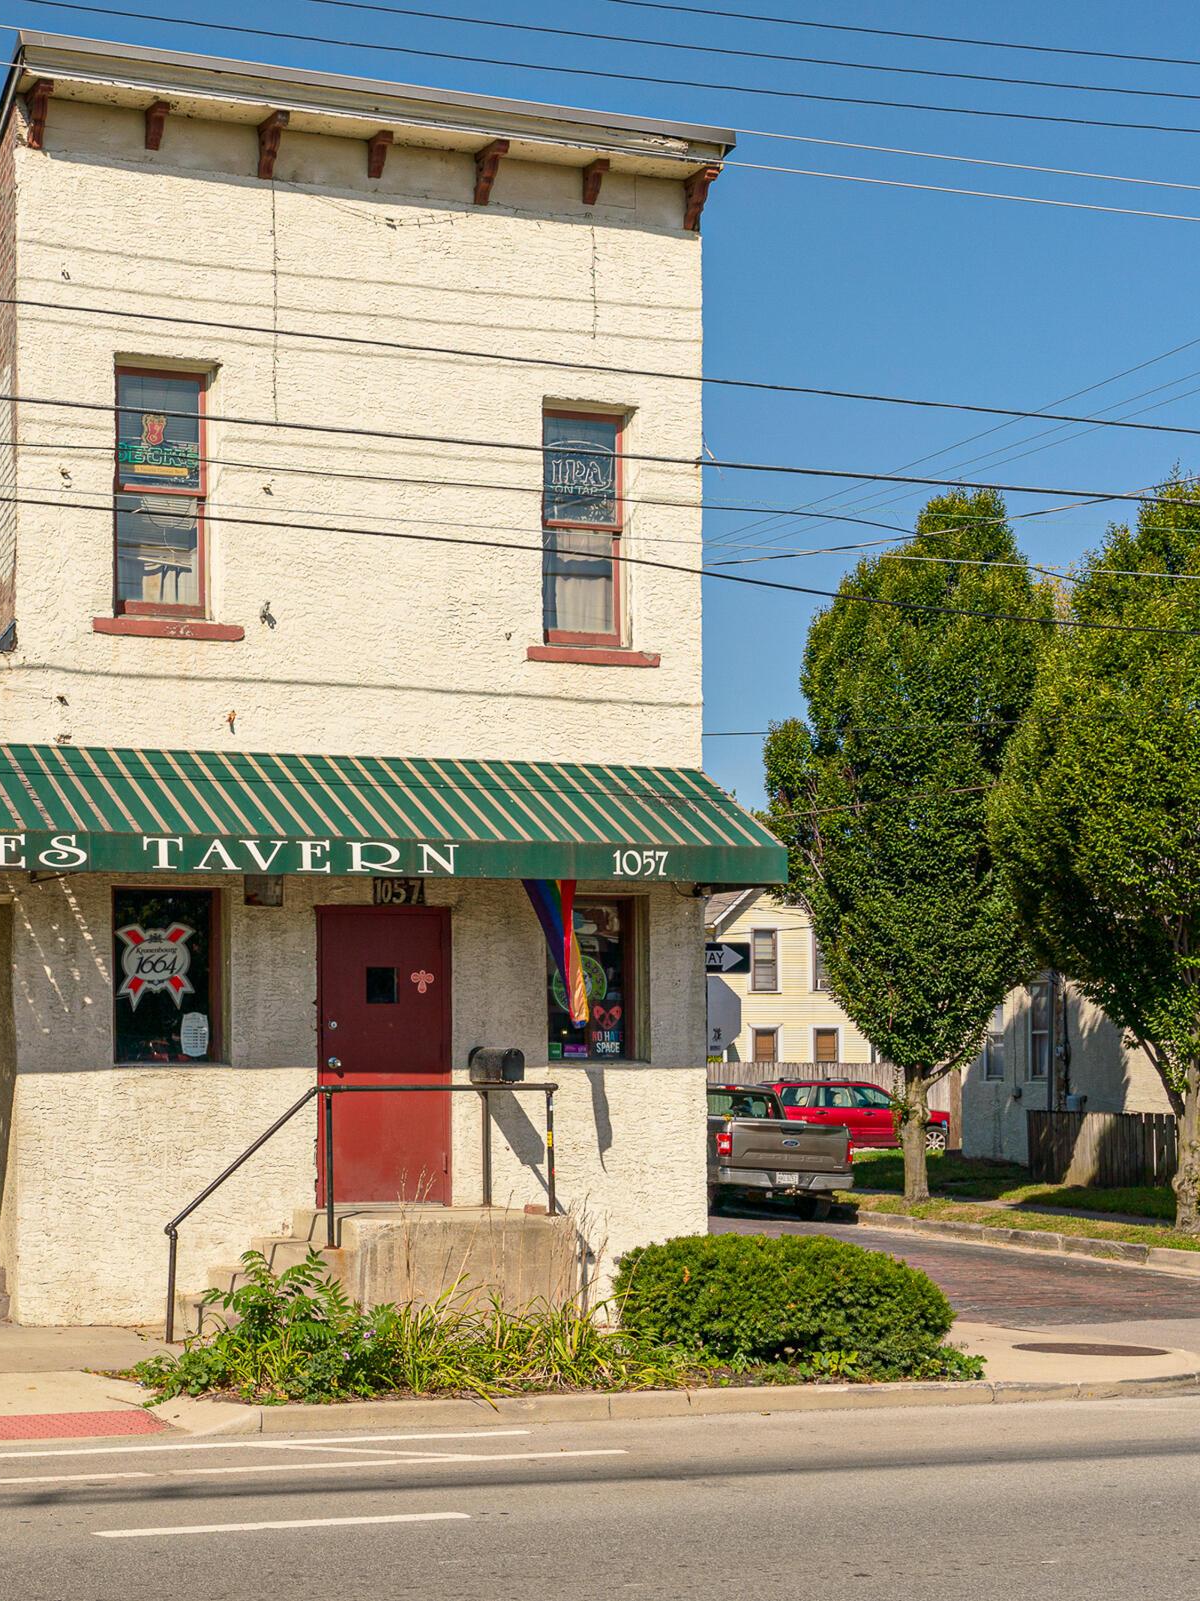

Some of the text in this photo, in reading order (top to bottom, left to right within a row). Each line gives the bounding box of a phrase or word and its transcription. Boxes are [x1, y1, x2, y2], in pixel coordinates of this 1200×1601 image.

[552, 460, 606, 486] IPA
[555, 486, 598, 495] ON TAP
[142, 835, 460, 875] TAVERN
[612, 849, 669, 876] 1057
[374, 879, 421, 904] 1057
[134, 953, 178, 975] 1664
[705, 951, 725, 964] AY
[591, 1031, 603, 1041] NO
[596, 1042, 620, 1053] SPACE
